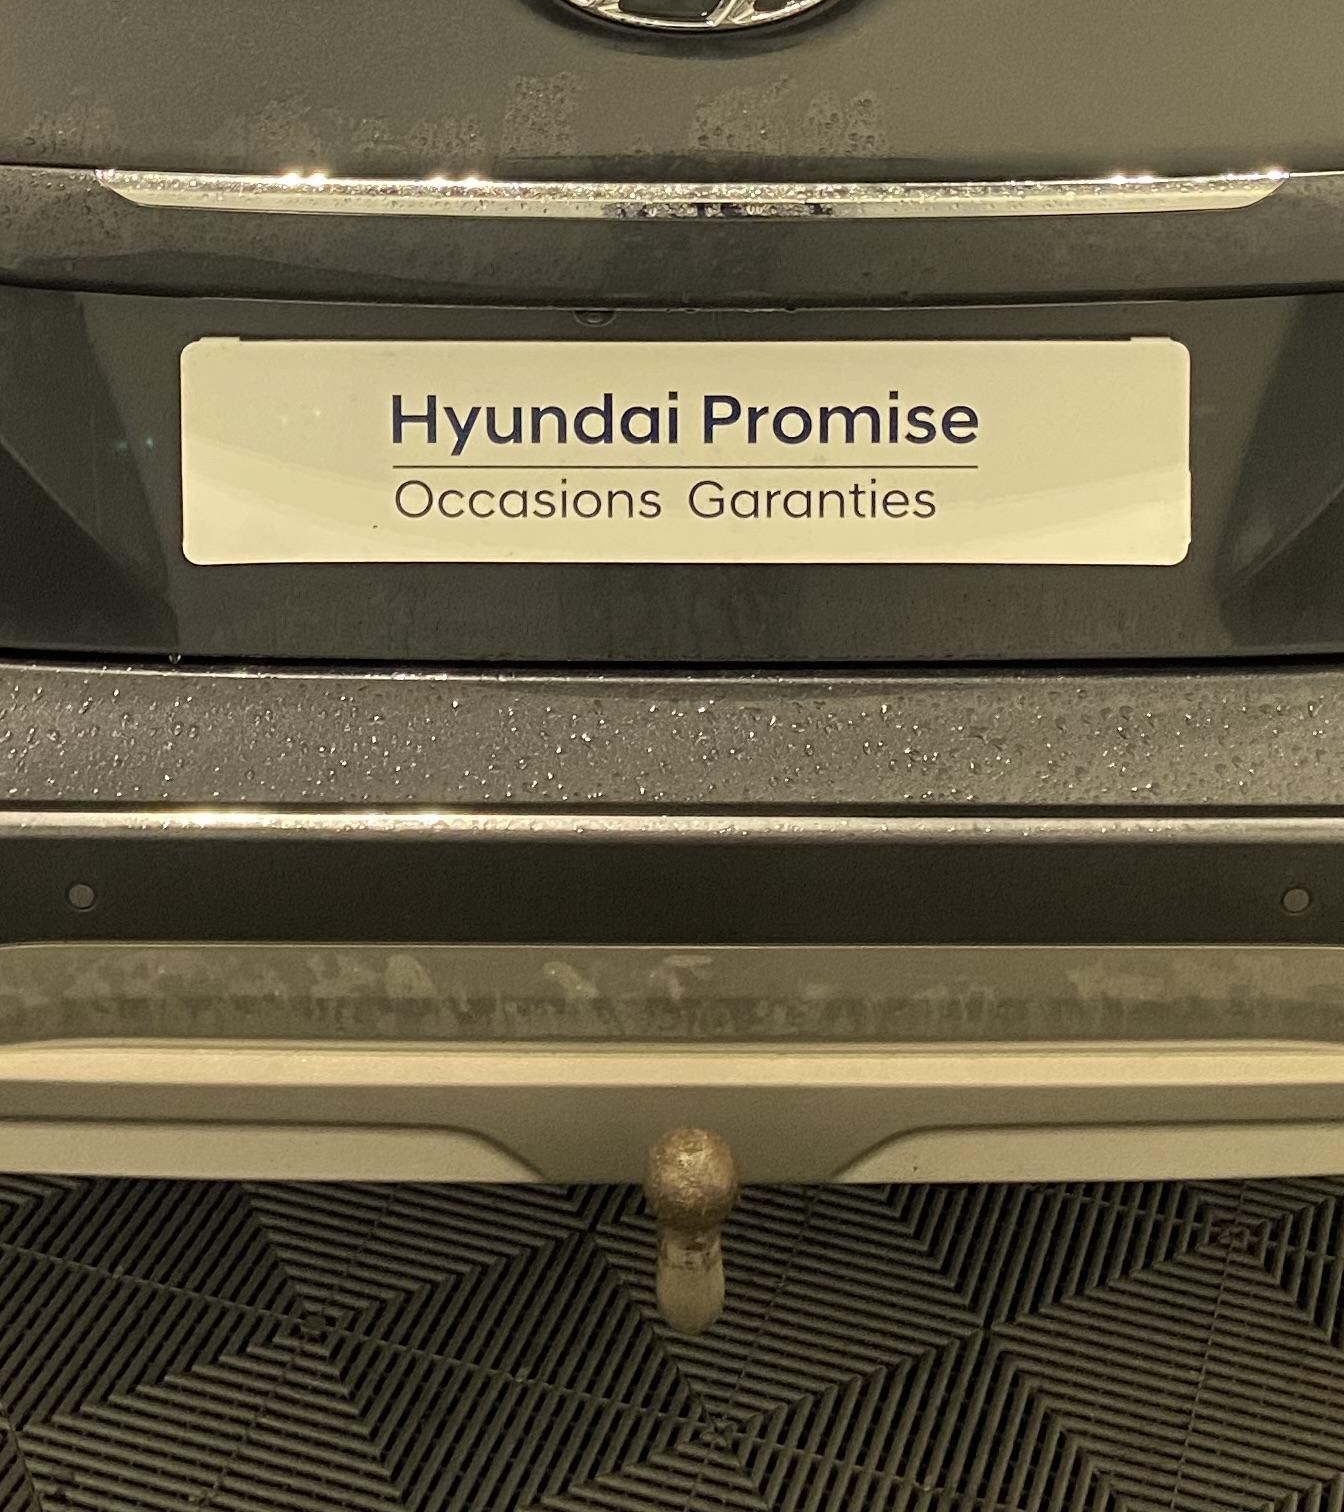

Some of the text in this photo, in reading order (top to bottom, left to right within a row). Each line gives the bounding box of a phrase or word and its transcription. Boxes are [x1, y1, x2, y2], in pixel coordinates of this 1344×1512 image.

[393, 391, 978, 455] Hyundai Promise
[396, 479, 935, 518] Occasions Garanties
